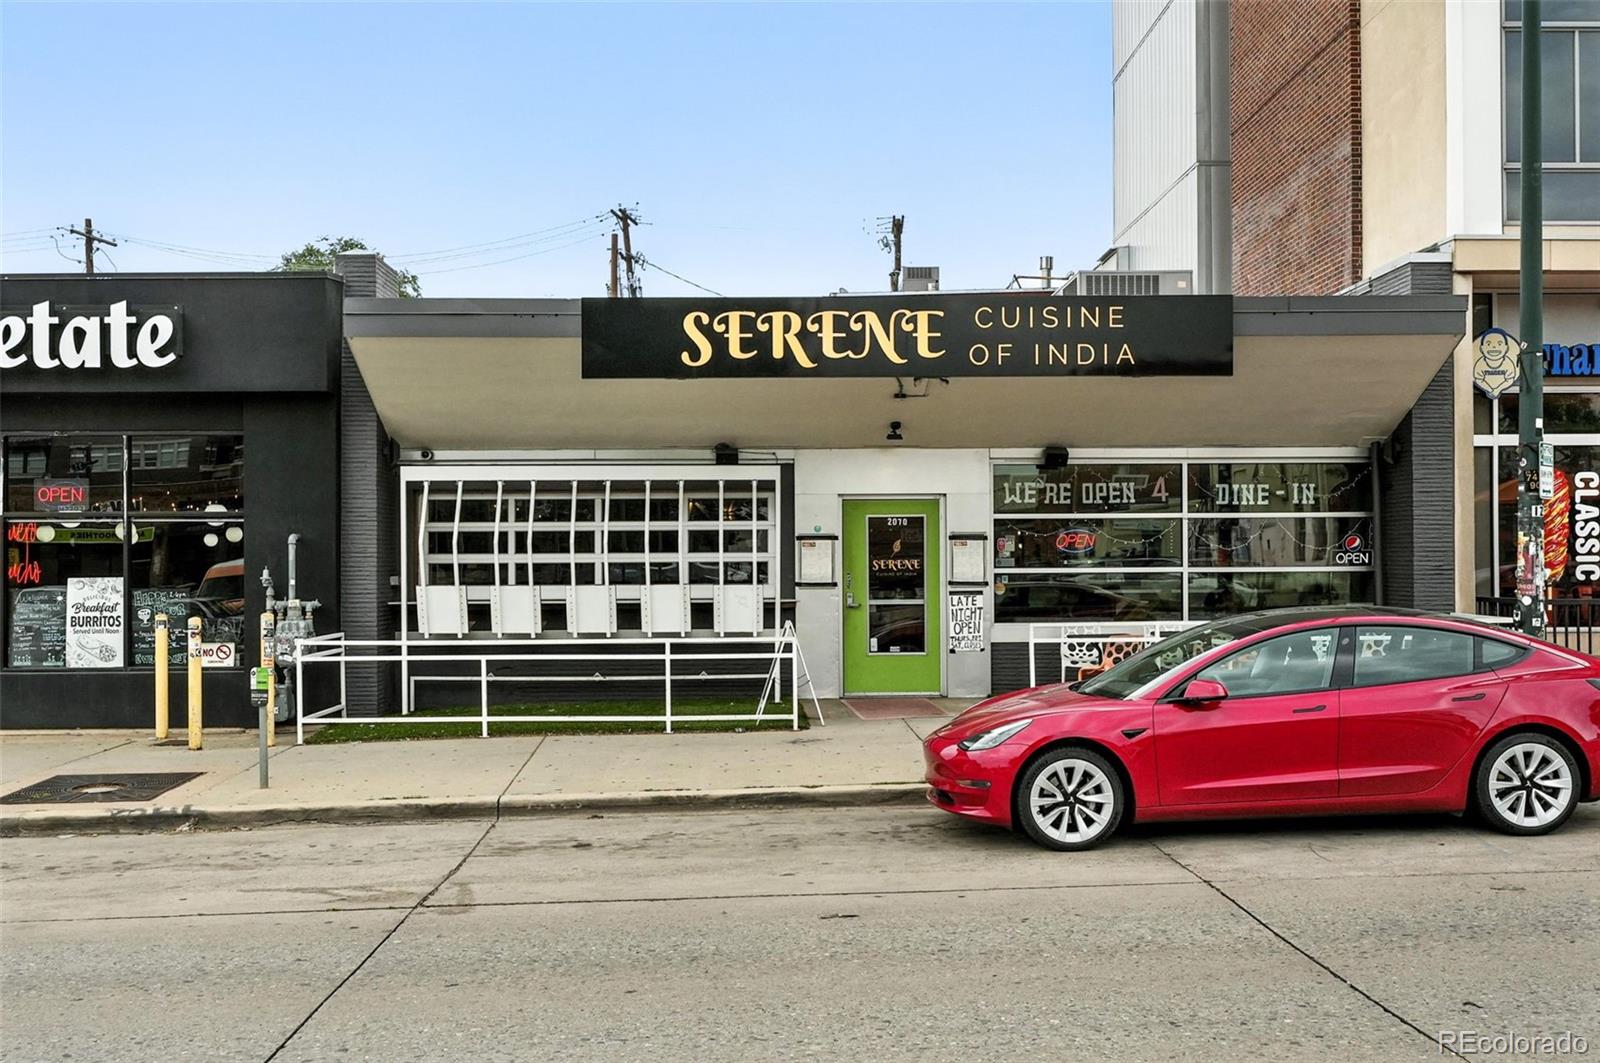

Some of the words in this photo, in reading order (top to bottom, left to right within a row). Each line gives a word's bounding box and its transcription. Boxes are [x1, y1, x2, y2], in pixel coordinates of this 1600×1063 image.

[974, 306, 1125, 329] CUISINE
[0, 299, 178, 369] etate
[680, 309, 946, 368] SERENE
[968, 344, 1012, 367] OF
[1034, 343, 1136, 366] INDIA
[37, 487, 84, 503] OPEN
[1003, 478, 1072, 506] WE'RE
[1081, 482, 1136, 505] OPEN
[1151, 476, 1169, 502] 4
[1574, 470, 1600, 582] CLASSIC
[1055, 533, 1096, 550] OPEN
[872, 559, 921, 571] SERENE
[1335, 552, 1370, 565] OPEN
[71, 602, 121, 615] Breakfast
[950, 595, 977, 607] LATE
[70, 615, 122, 628] BURRITOS
[951, 607, 983, 622] NIGHT
[72, 627, 91, 635] Served
[91, 627, 105, 635] Until
[105, 627, 120, 635] Noon
[953, 621, 981, 635] OPEN
[202, 648, 214, 657] NO
